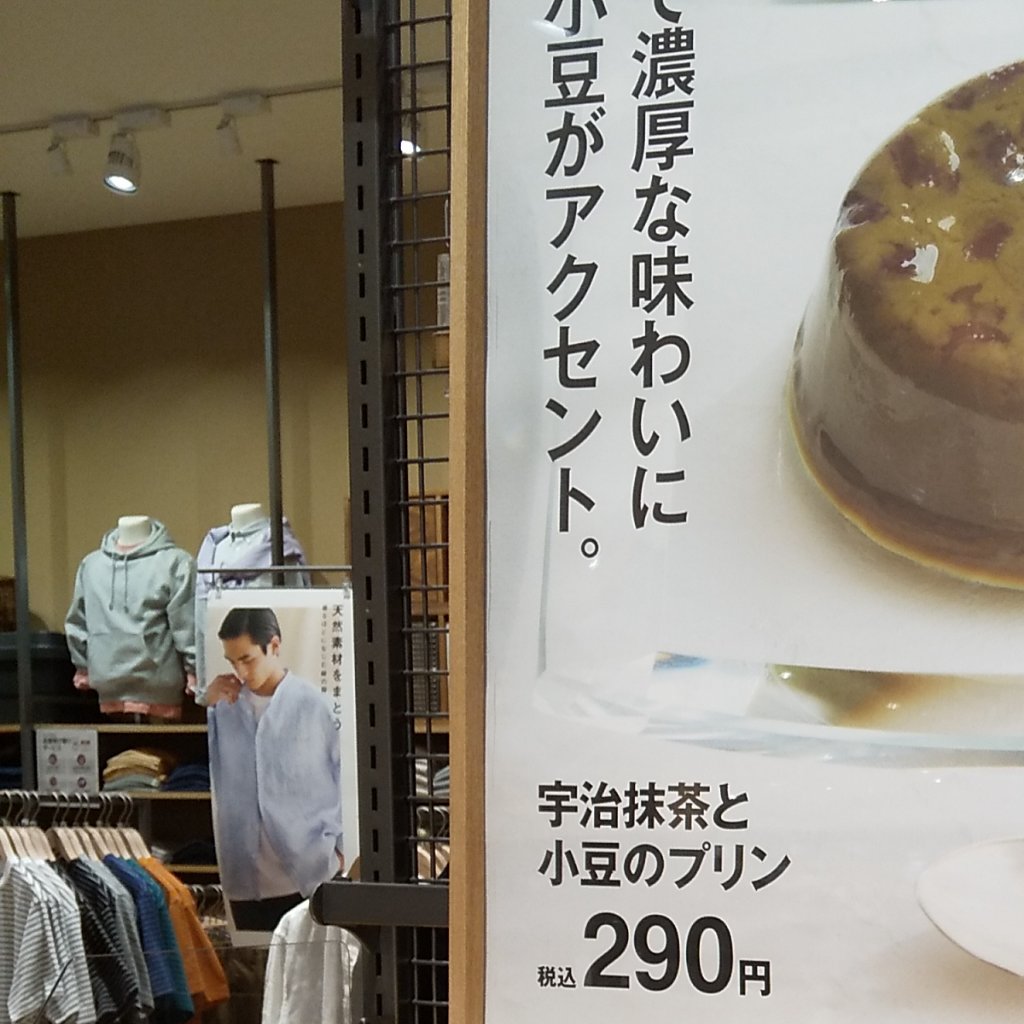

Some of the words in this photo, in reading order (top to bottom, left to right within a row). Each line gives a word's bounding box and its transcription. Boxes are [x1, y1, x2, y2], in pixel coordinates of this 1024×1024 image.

[332, 603, 344, 731] 天然素材をまとう
[538, 780, 749, 830] 宇治抹茶と
[538, 839, 792, 891] 小豆のプリン
